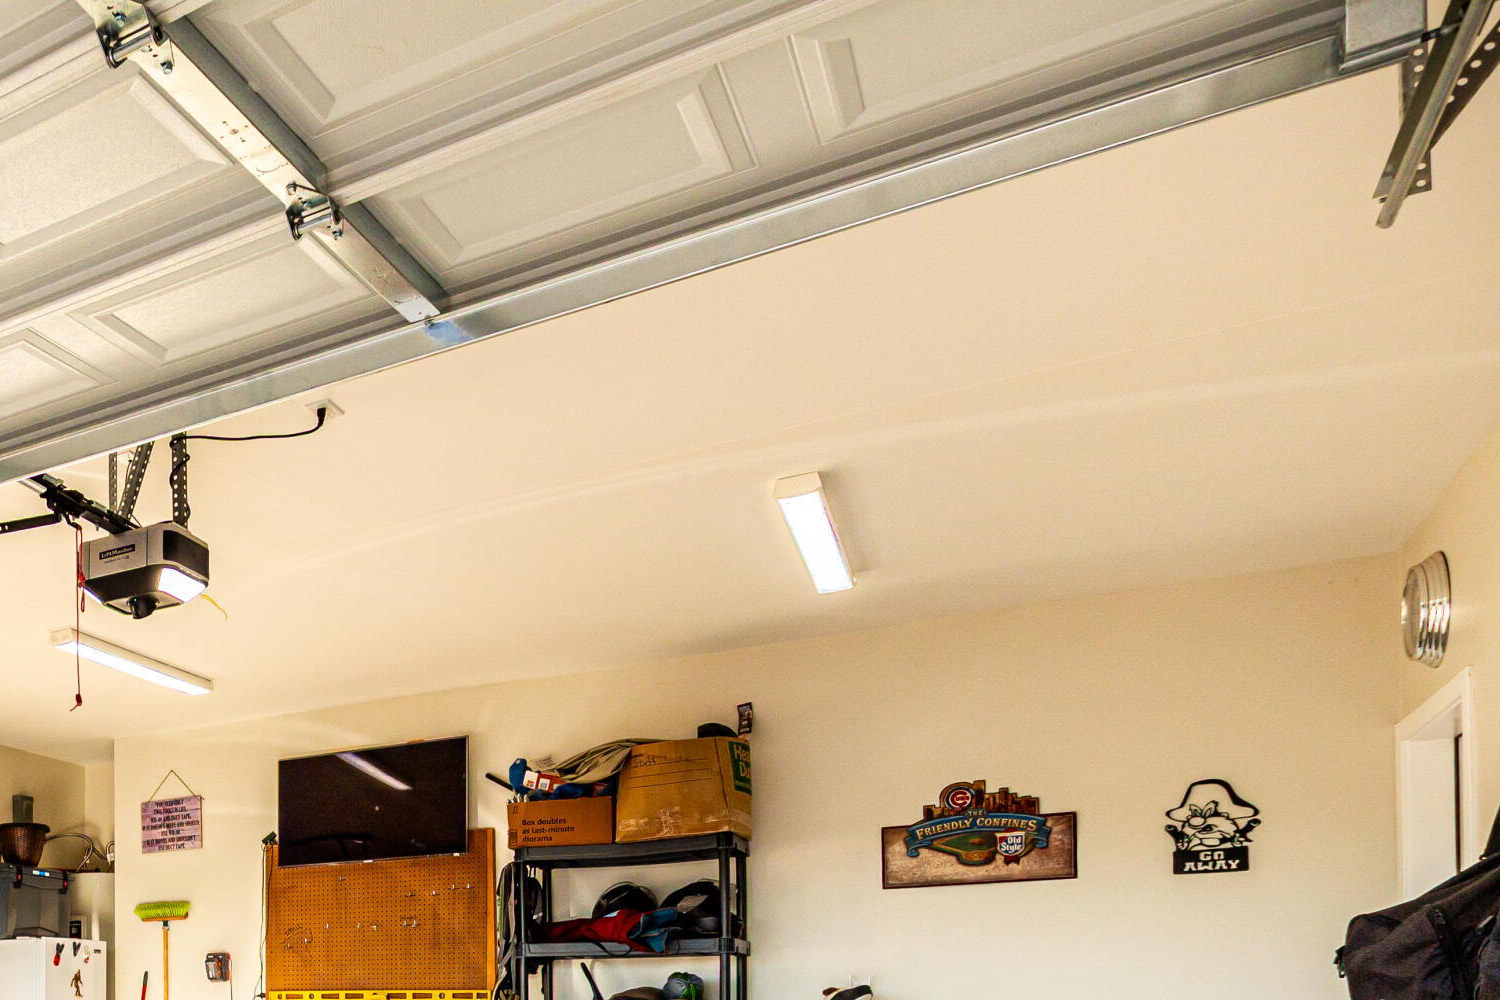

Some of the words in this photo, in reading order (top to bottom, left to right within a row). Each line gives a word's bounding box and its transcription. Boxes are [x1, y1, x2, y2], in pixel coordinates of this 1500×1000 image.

[522, 818, 535, 826] Box
[537, 817, 567, 825] doubles
[532, 825, 575, 834] last-minute
[914, 817, 973, 841] FRIENDLY
[976, 816, 1038, 832] CONFINES
[522, 835, 553, 843] diorama
[1007, 836, 1022, 845] Old
[1000, 841, 1023, 853] Style
[1199, 850, 1224, 861] GO
[1183, 859, 1240, 872] AWAY
